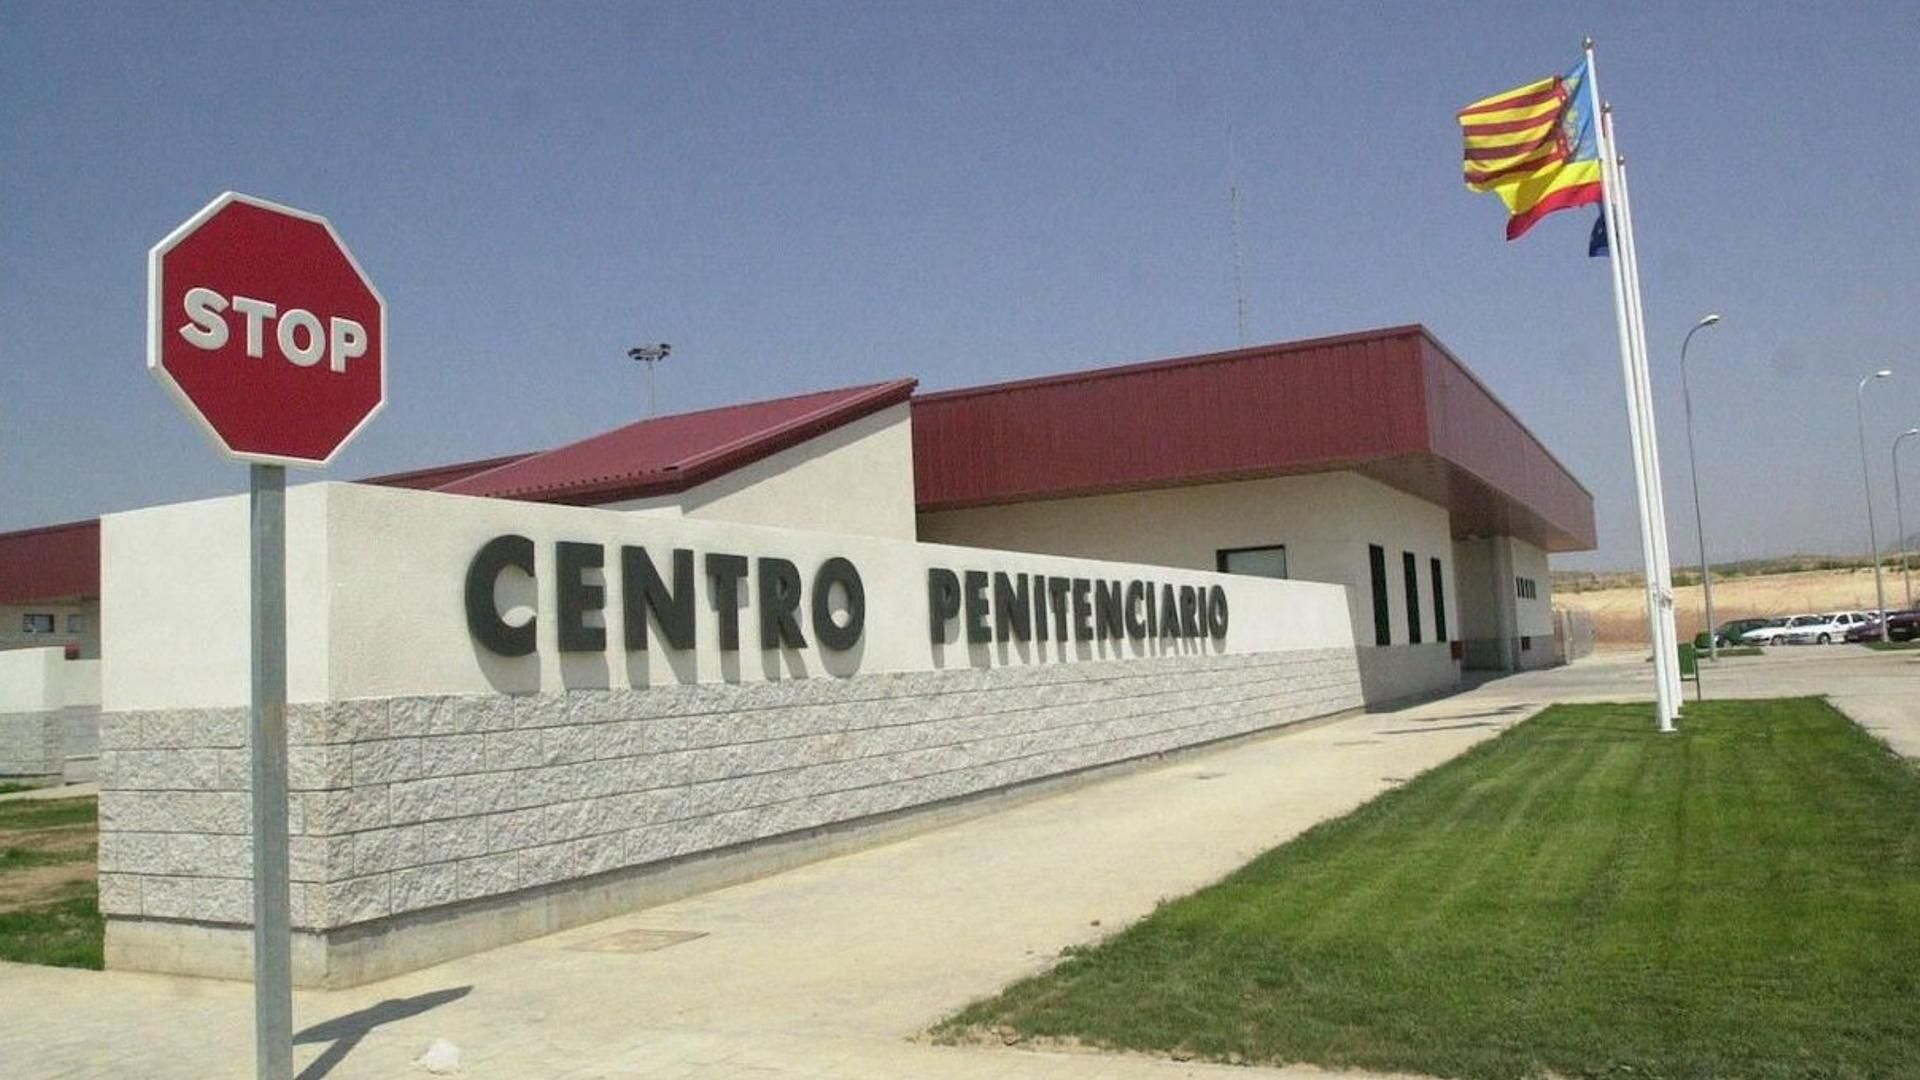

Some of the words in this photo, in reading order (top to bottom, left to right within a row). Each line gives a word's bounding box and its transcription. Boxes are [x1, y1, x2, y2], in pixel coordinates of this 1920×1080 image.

[178, 287, 368, 373] STOP
[464, 534, 865, 656] CENTRO
[928, 567, 1229, 644] PENITENCIARIO
